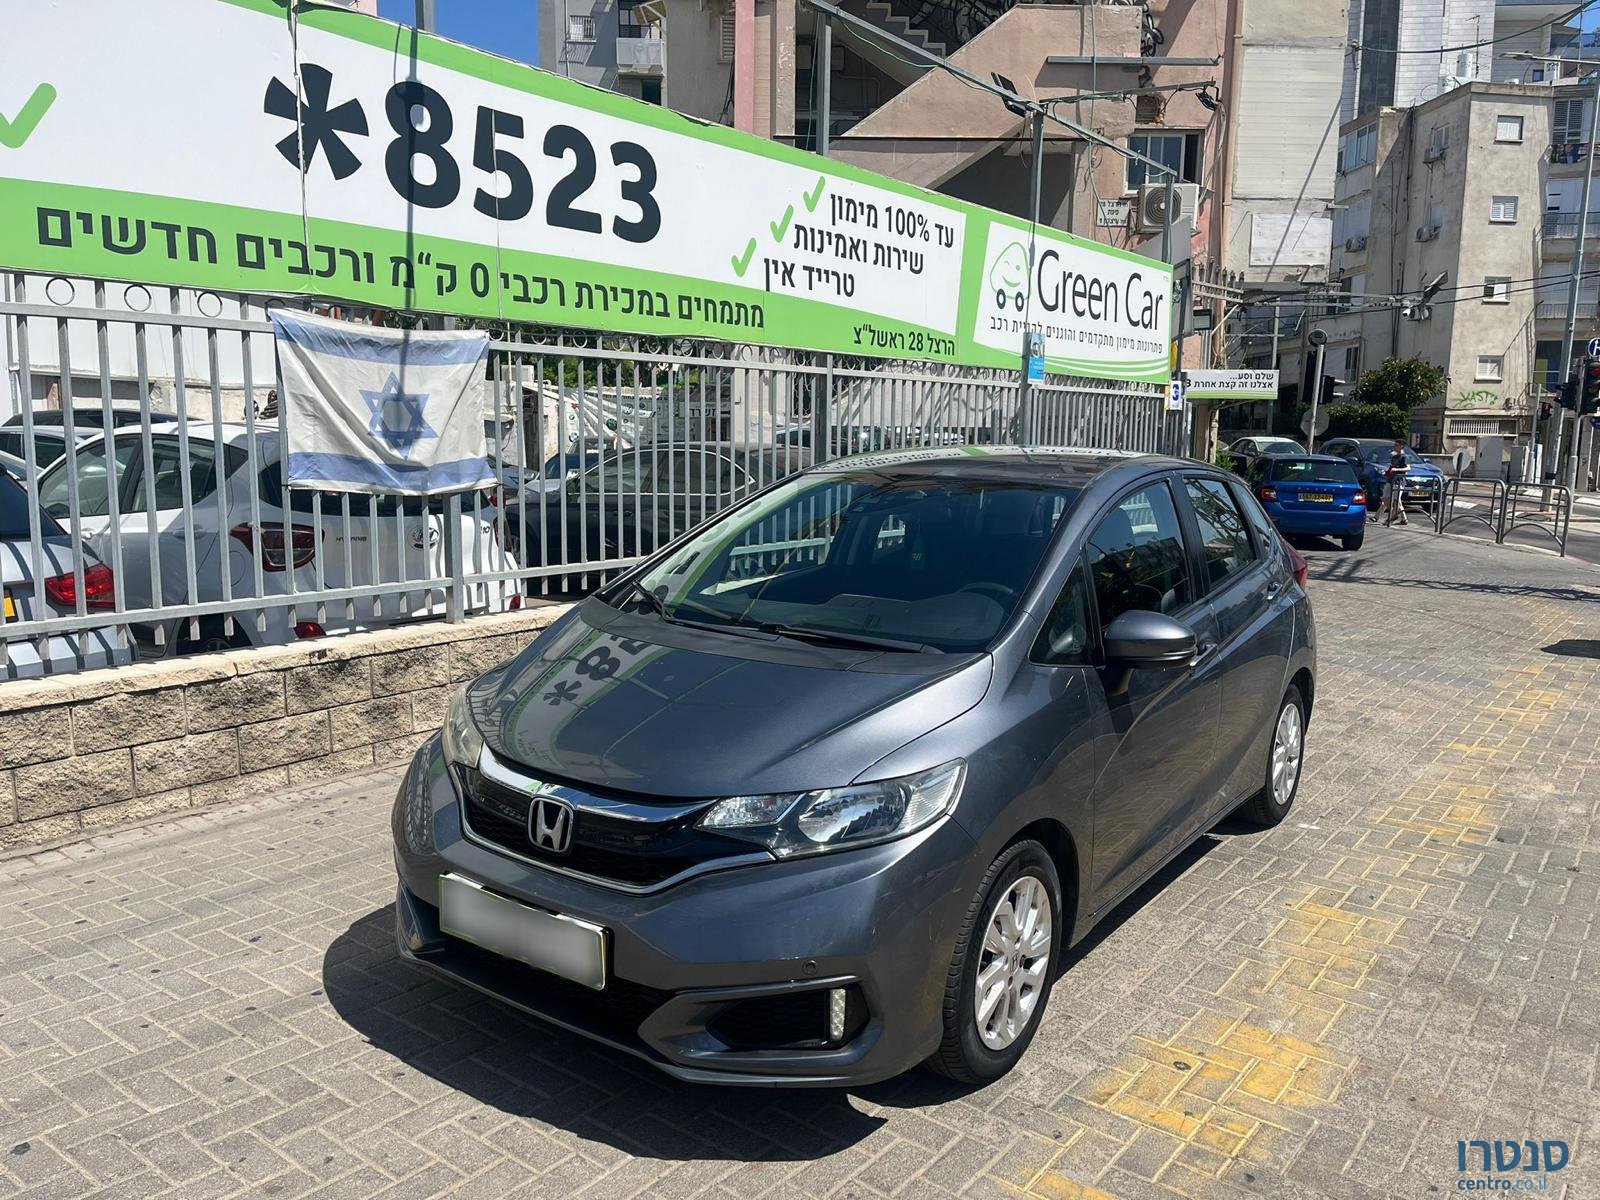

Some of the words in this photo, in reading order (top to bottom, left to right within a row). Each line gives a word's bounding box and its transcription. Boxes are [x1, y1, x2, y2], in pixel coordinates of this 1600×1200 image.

[830, 193, 878, 229] מימון
[884, 206, 930, 242] 100%
[36, 206, 218, 265] חדשים
[793, 224, 867, 263] ואמינות
[934, 223, 954, 249] עד
[236, 232, 375, 284] ורכבים
[872, 243, 924, 275] שירות
[469, 262, 490, 298] 0
[499, 271, 566, 307] רכבי
[763, 257, 796, 292] אין
[802, 264, 855, 297] טרייד
[1037, 249, 1118, 323] Green
[1125, 272, 1163, 331] Car
[574, 280, 671, 318] במכירת
[677, 293, 765, 329] מתמחים
[990, 316, 1008, 331] רכב
[1046, 325, 1076, 341] והוגנים
[908, 330, 924, 352] 28
[926, 333, 955, 357] הרצל
[1079, 331, 1114, 349] מתקדמים
[1116, 336, 1135, 351] מימון
[1136, 340, 1163, 354] פתרונות
[1193, 380, 1216, 388] אחרת
[1218, 380, 1237, 390] קצת
[1250, 380, 1274, 388] אצלנו
[1254, 372, 1274, 380] שלם
